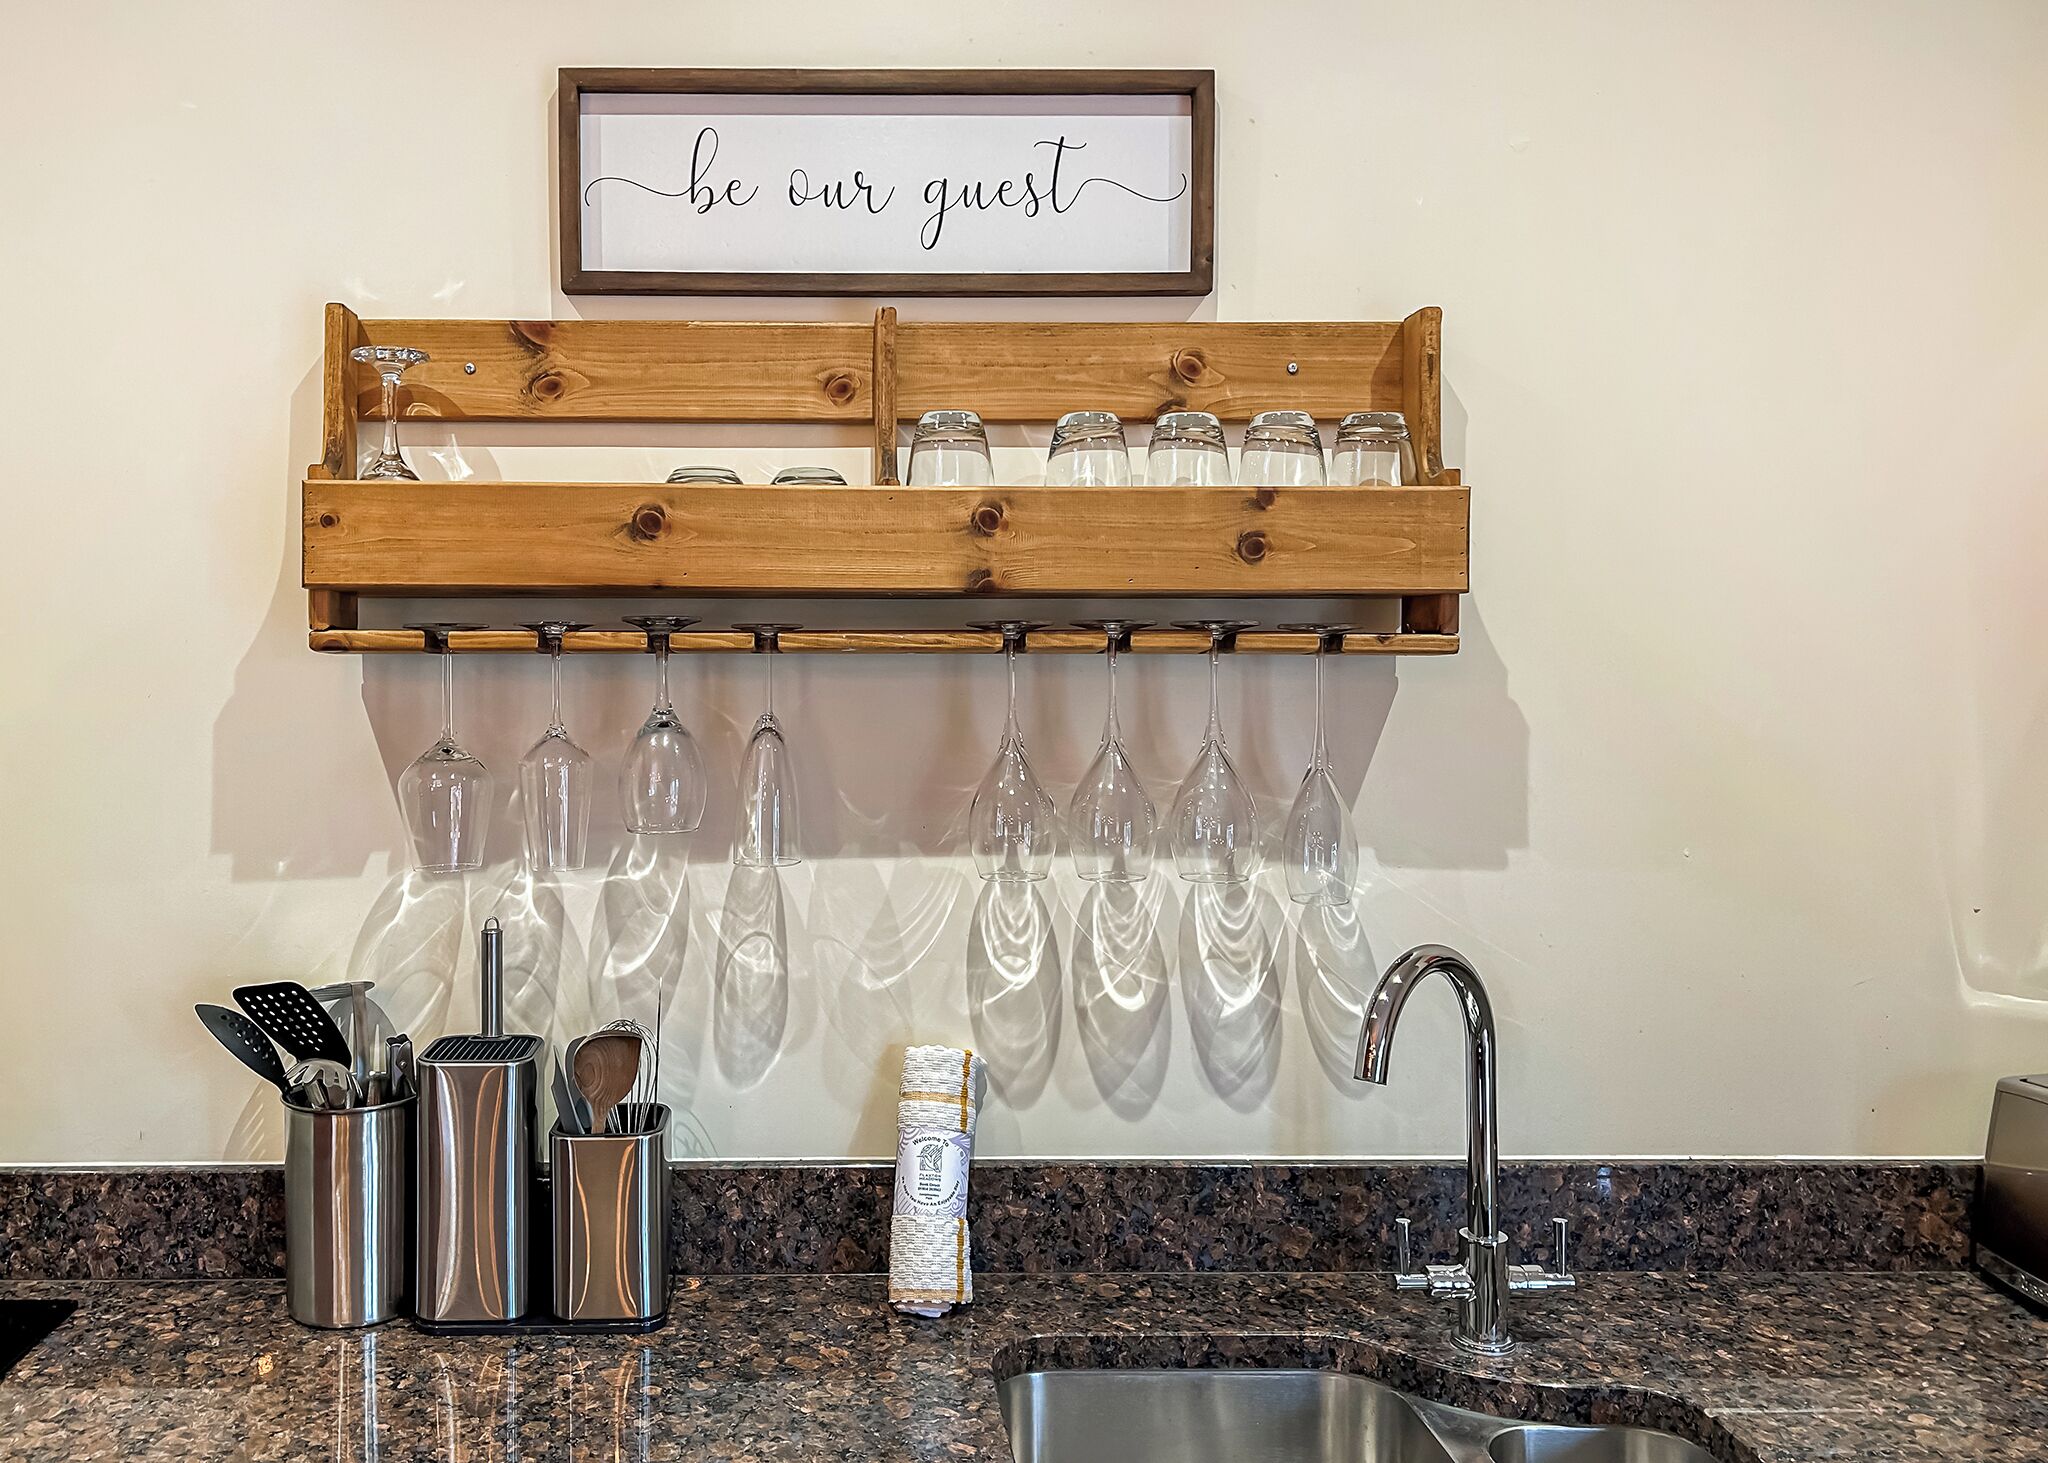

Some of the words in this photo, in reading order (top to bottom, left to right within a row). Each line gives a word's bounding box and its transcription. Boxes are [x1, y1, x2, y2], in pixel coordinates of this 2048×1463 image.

[788, 168, 895, 214] our
[920, 136, 1187, 250] guest
[912, 1136, 941, 1145] Welcome
[943, 1138, 949, 1147] To
